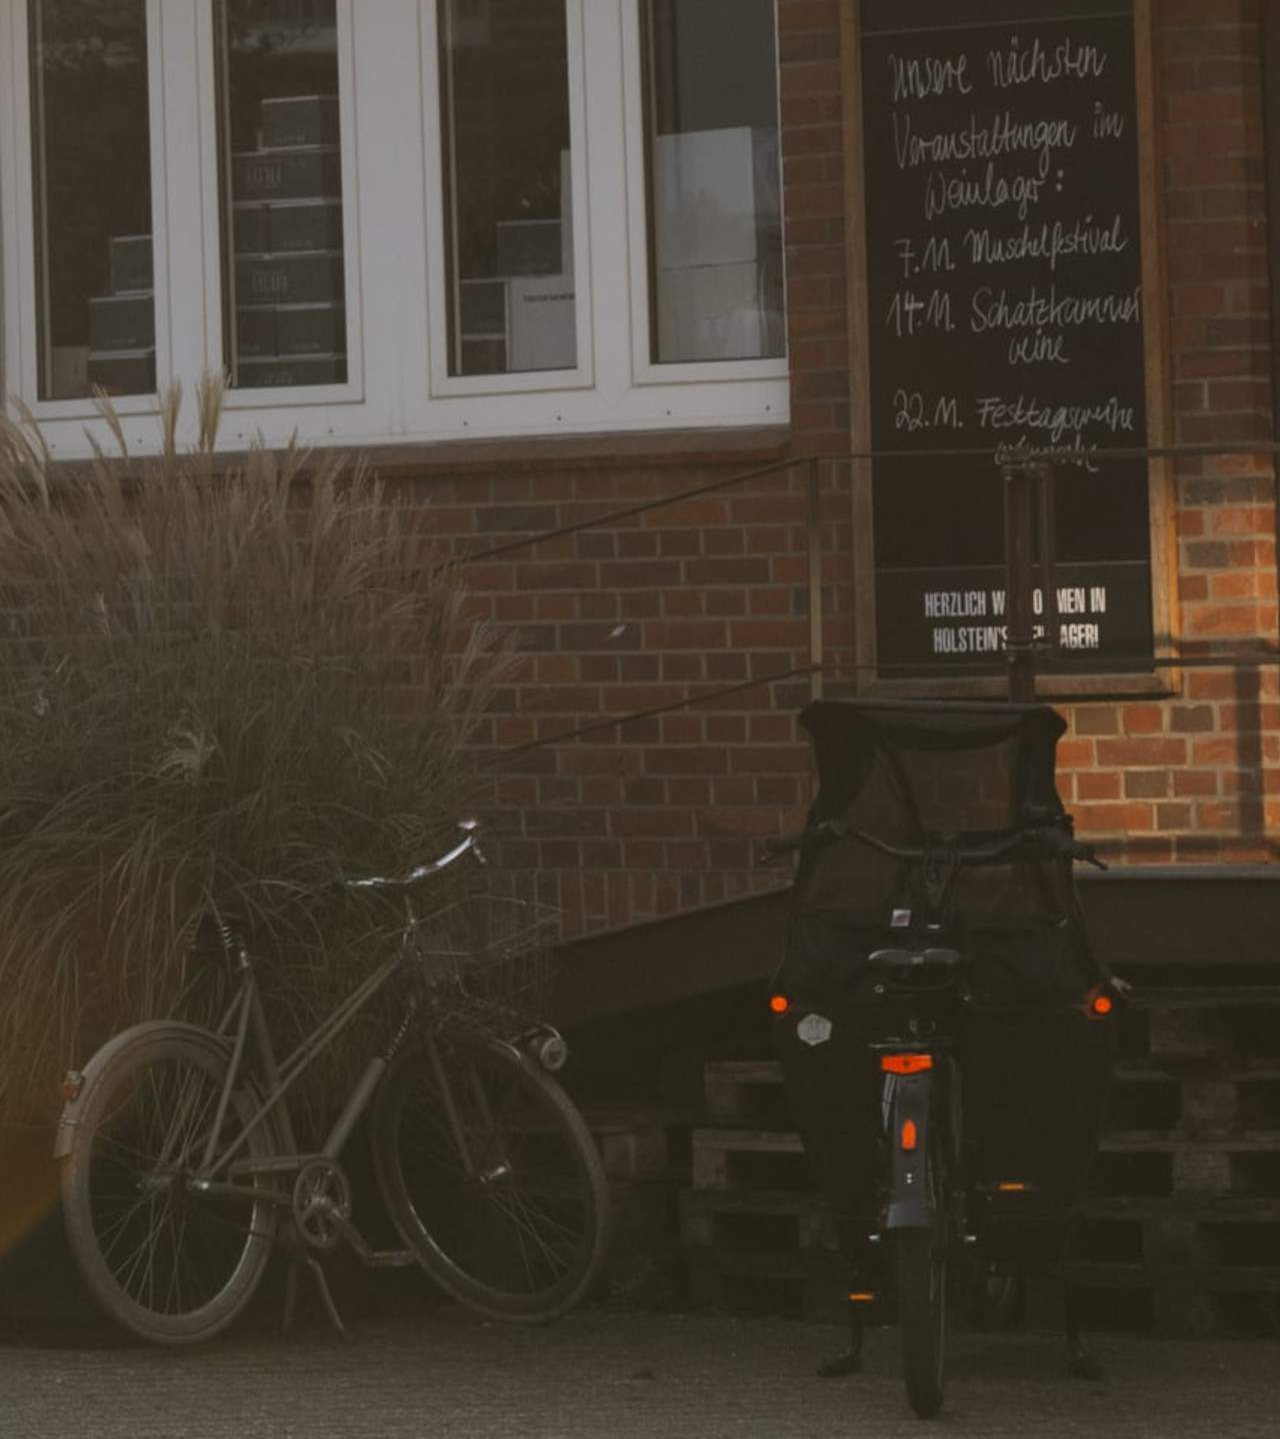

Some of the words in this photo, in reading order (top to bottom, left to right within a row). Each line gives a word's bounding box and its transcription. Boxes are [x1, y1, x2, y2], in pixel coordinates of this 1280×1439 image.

[892, 112, 1078, 177] Veranstaltungen
[1093, 101, 1125, 139] im
[964, 214, 1128, 271] Muschelfestival
[925, 590, 986, 618] HERZLICH
[1090, 586, 1107, 613] IN
